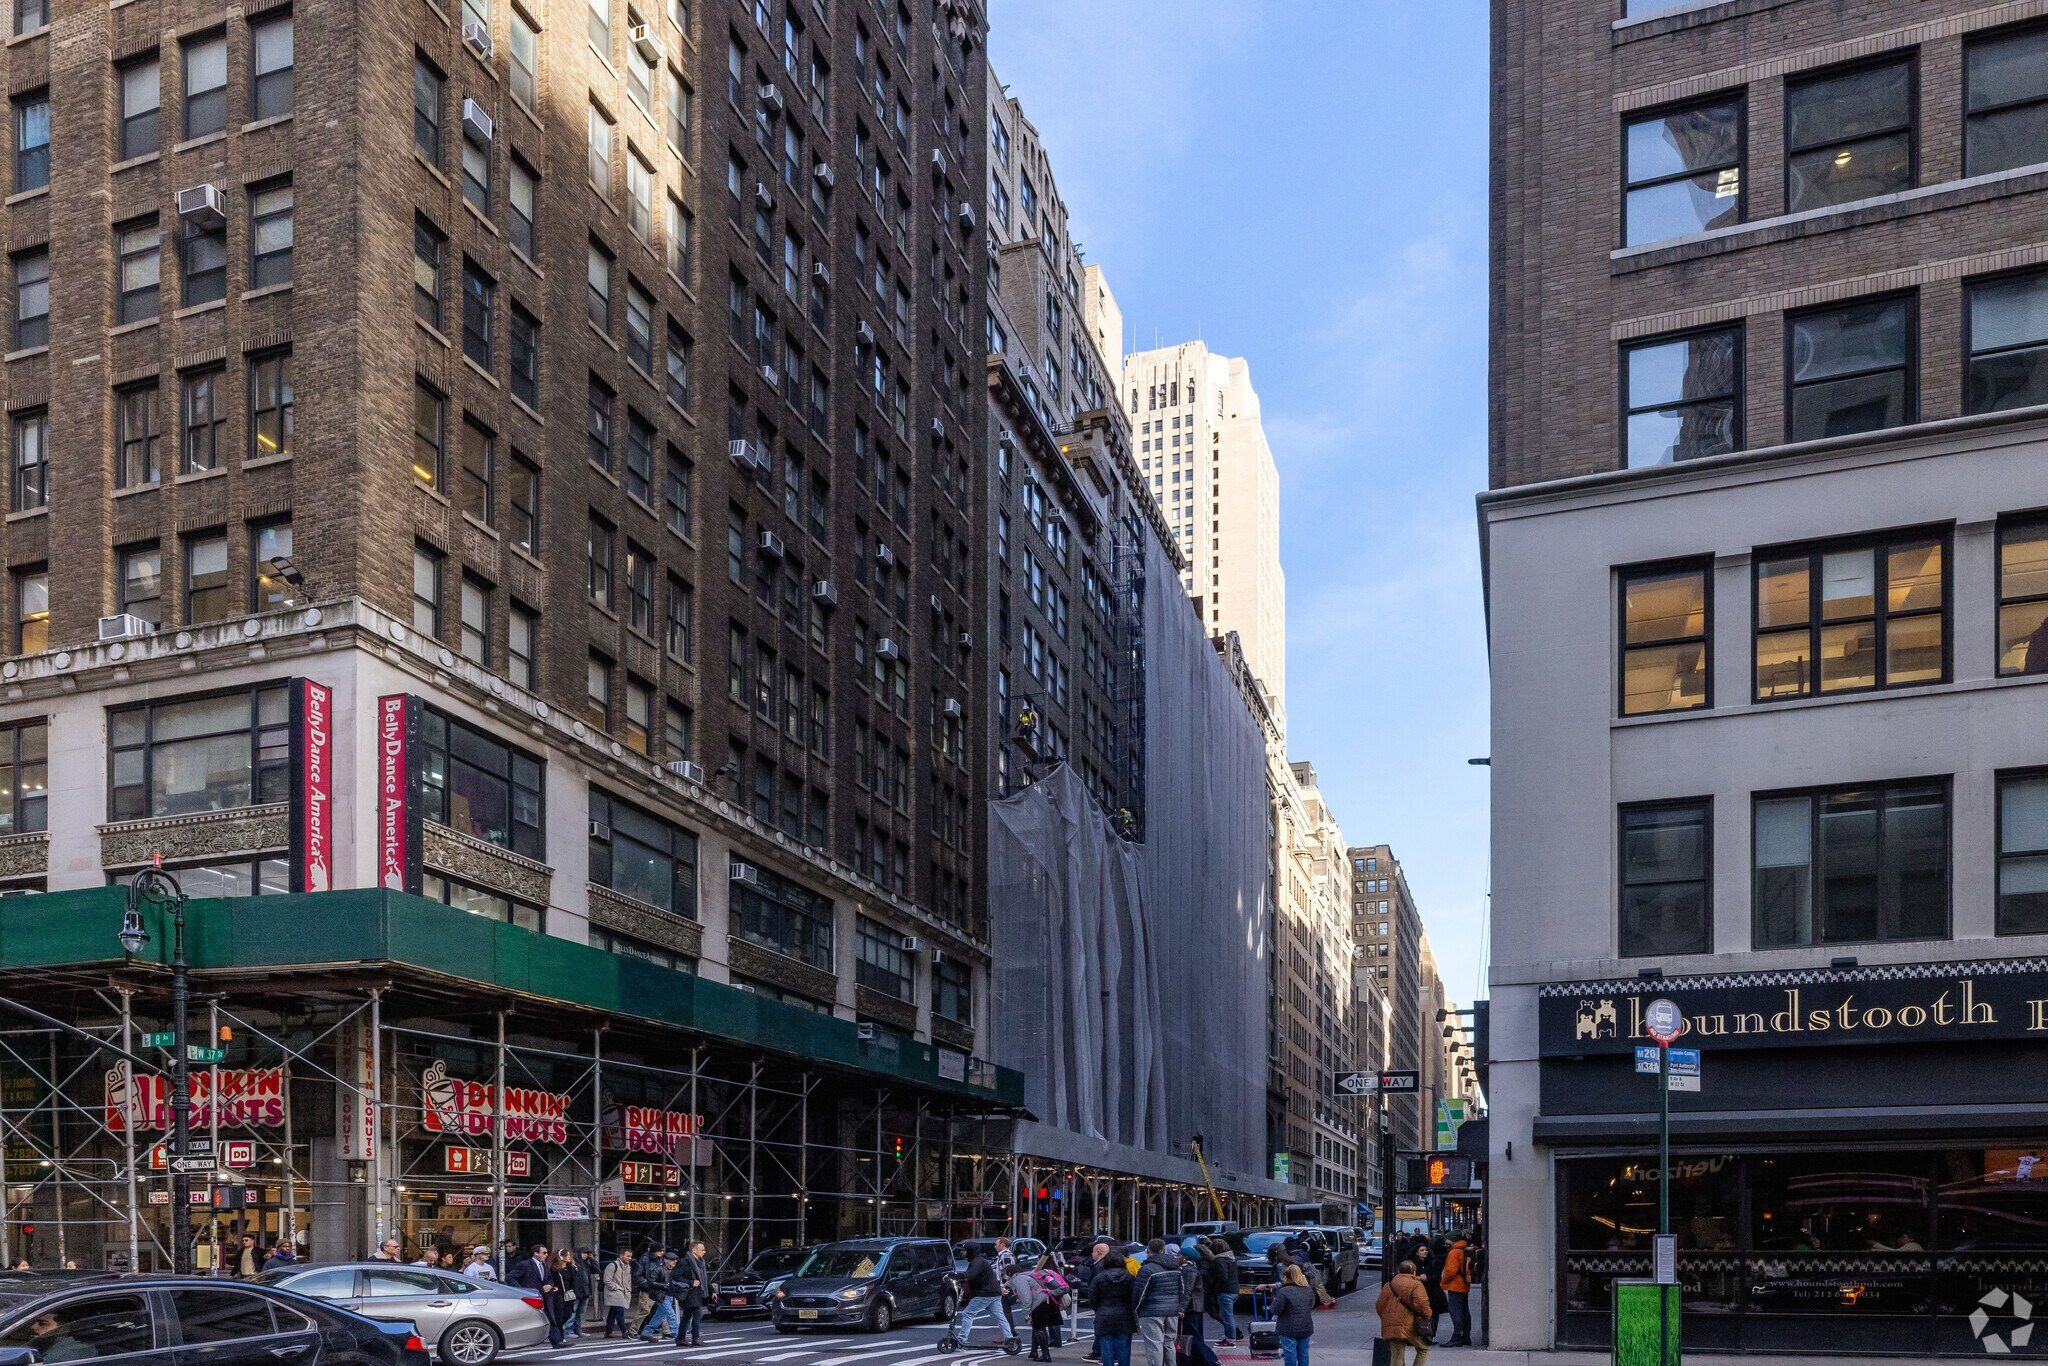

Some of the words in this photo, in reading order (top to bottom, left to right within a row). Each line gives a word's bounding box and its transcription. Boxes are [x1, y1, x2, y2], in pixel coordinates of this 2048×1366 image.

[307, 685, 326, 783] BellyDance
[382, 699, 402, 793] BellyDance
[310, 786, 326, 857] America
[385, 798, 402, 866] America
[155, 1034, 161, 1045] 8
[197, 1048, 204, 1059] W
[206, 1050, 216, 1060] 37
[217, 1050, 223, 1058] St
[1637, 1048, 1656, 1059] M20
[1346, 1078, 1371, 1088] ONE
[1383, 1077, 1409, 1087] WAY
[343, 1094, 352, 1155] DONUTS
[365, 1097, 374, 1157] DONUTS
[191, 1141, 206, 1149] WAY
[629, 1130, 690, 1154] DONU
[233, 1150, 248, 1159] DD
[197, 1160, 213, 1168] WAY
[453, 1161, 462, 1169] NY
[513, 1160, 524, 1169] DD
[470, 1196, 492, 1205] OPEN
[504, 1197, 530, 1207] HOURS
[649, 1202, 677, 1212] UPSIRS
[1770, 1279, 1904, 1288] www.houndstoothpub.com
[1792, 1290, 1812, 1298] Tel:
[1813, 1290, 1832, 1298] 212
